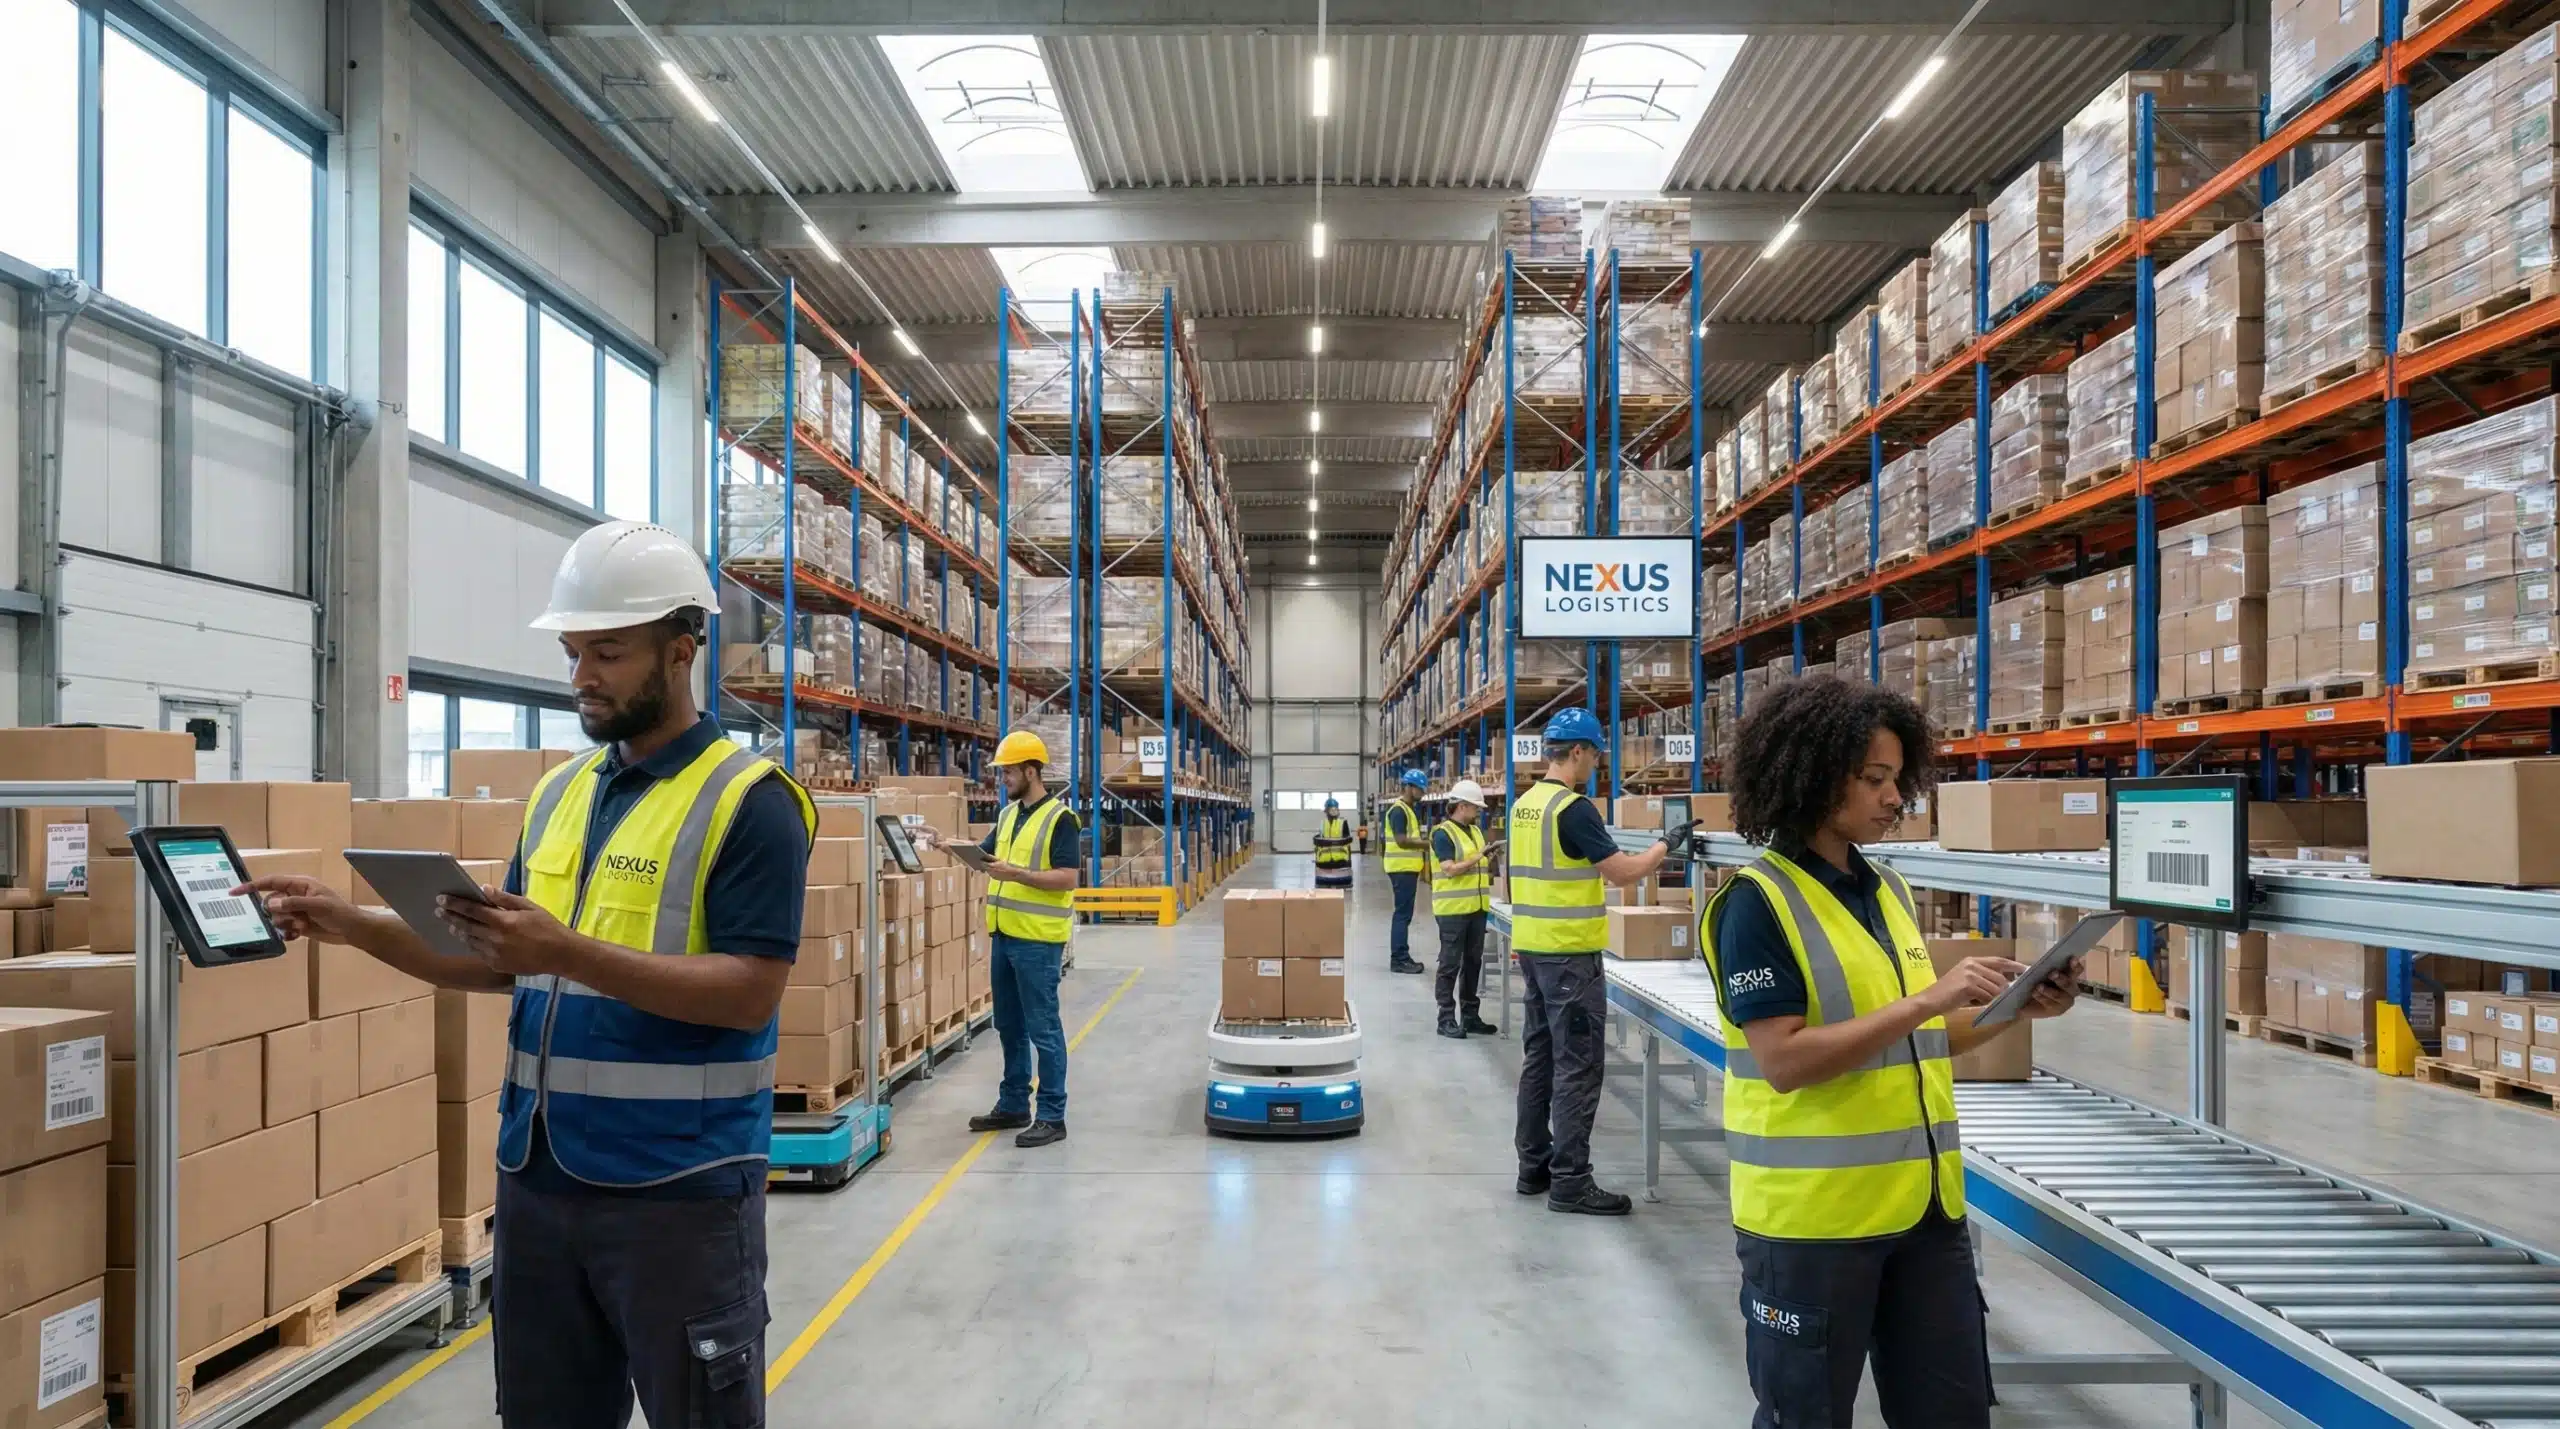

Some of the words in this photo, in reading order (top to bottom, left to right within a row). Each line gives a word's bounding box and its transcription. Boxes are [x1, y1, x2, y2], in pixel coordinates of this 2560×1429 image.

[1545, 563, 1670, 592] NEXUS
[1545, 597, 1669, 612] LOGISTICS
[605, 854, 659, 875] NEXUS
[1728, 967, 1773, 989] NEXUS
[1752, 1299, 1800, 1328] NEXUS
